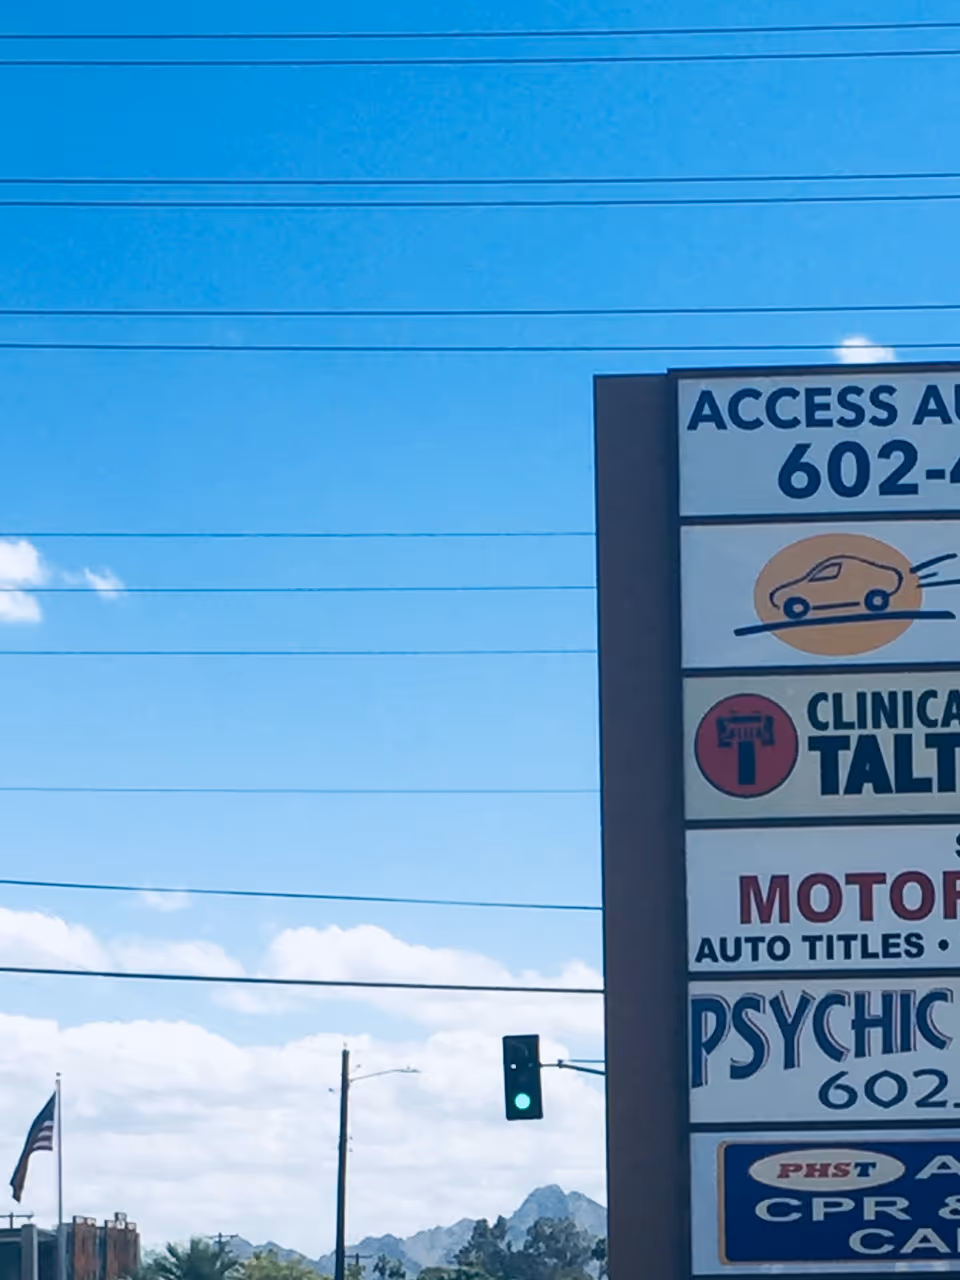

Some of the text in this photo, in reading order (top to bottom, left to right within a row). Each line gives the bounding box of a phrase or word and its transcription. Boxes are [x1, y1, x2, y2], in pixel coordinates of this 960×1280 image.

[687, 385, 897, 430] ACCESS
[695, 936, 790, 963] AUTO
[802, 933, 924, 960] TITLES
[690, 988, 953, 1087] PSYCHIC
[777, 1161, 877, 1179] PHST
[755, 1197, 911, 1221] CPR
